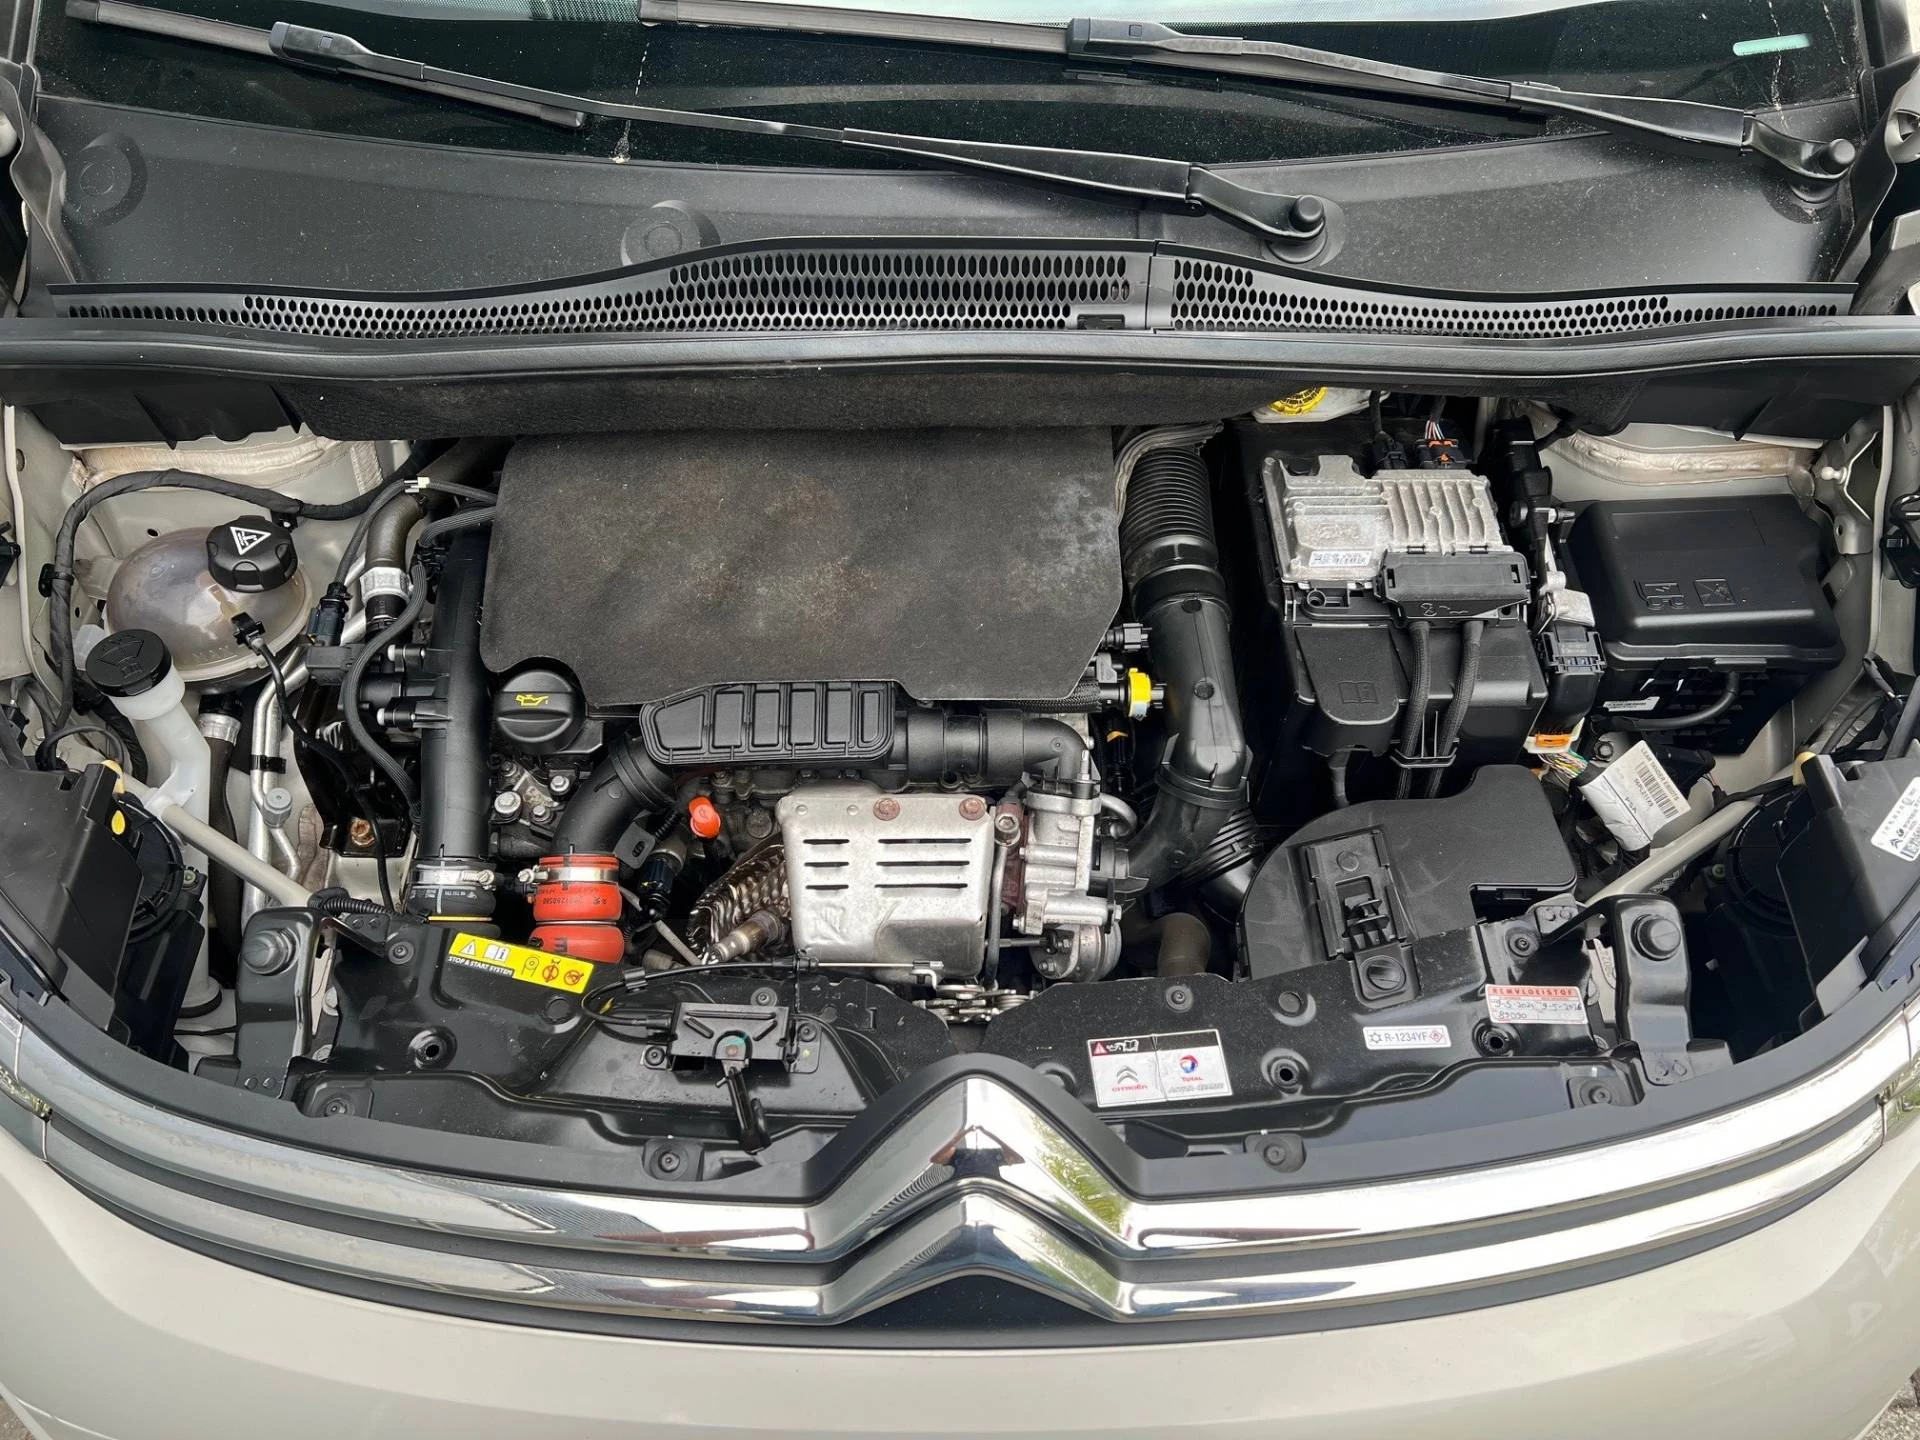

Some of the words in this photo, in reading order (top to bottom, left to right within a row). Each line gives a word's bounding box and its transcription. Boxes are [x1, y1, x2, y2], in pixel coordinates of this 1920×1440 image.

[448, 956, 466, 966] STOP
[470, 960, 490, 971] START
[489, 965, 513, 977] SYSTEM
[1383, 1032, 1428, 1043] R-1234YF
